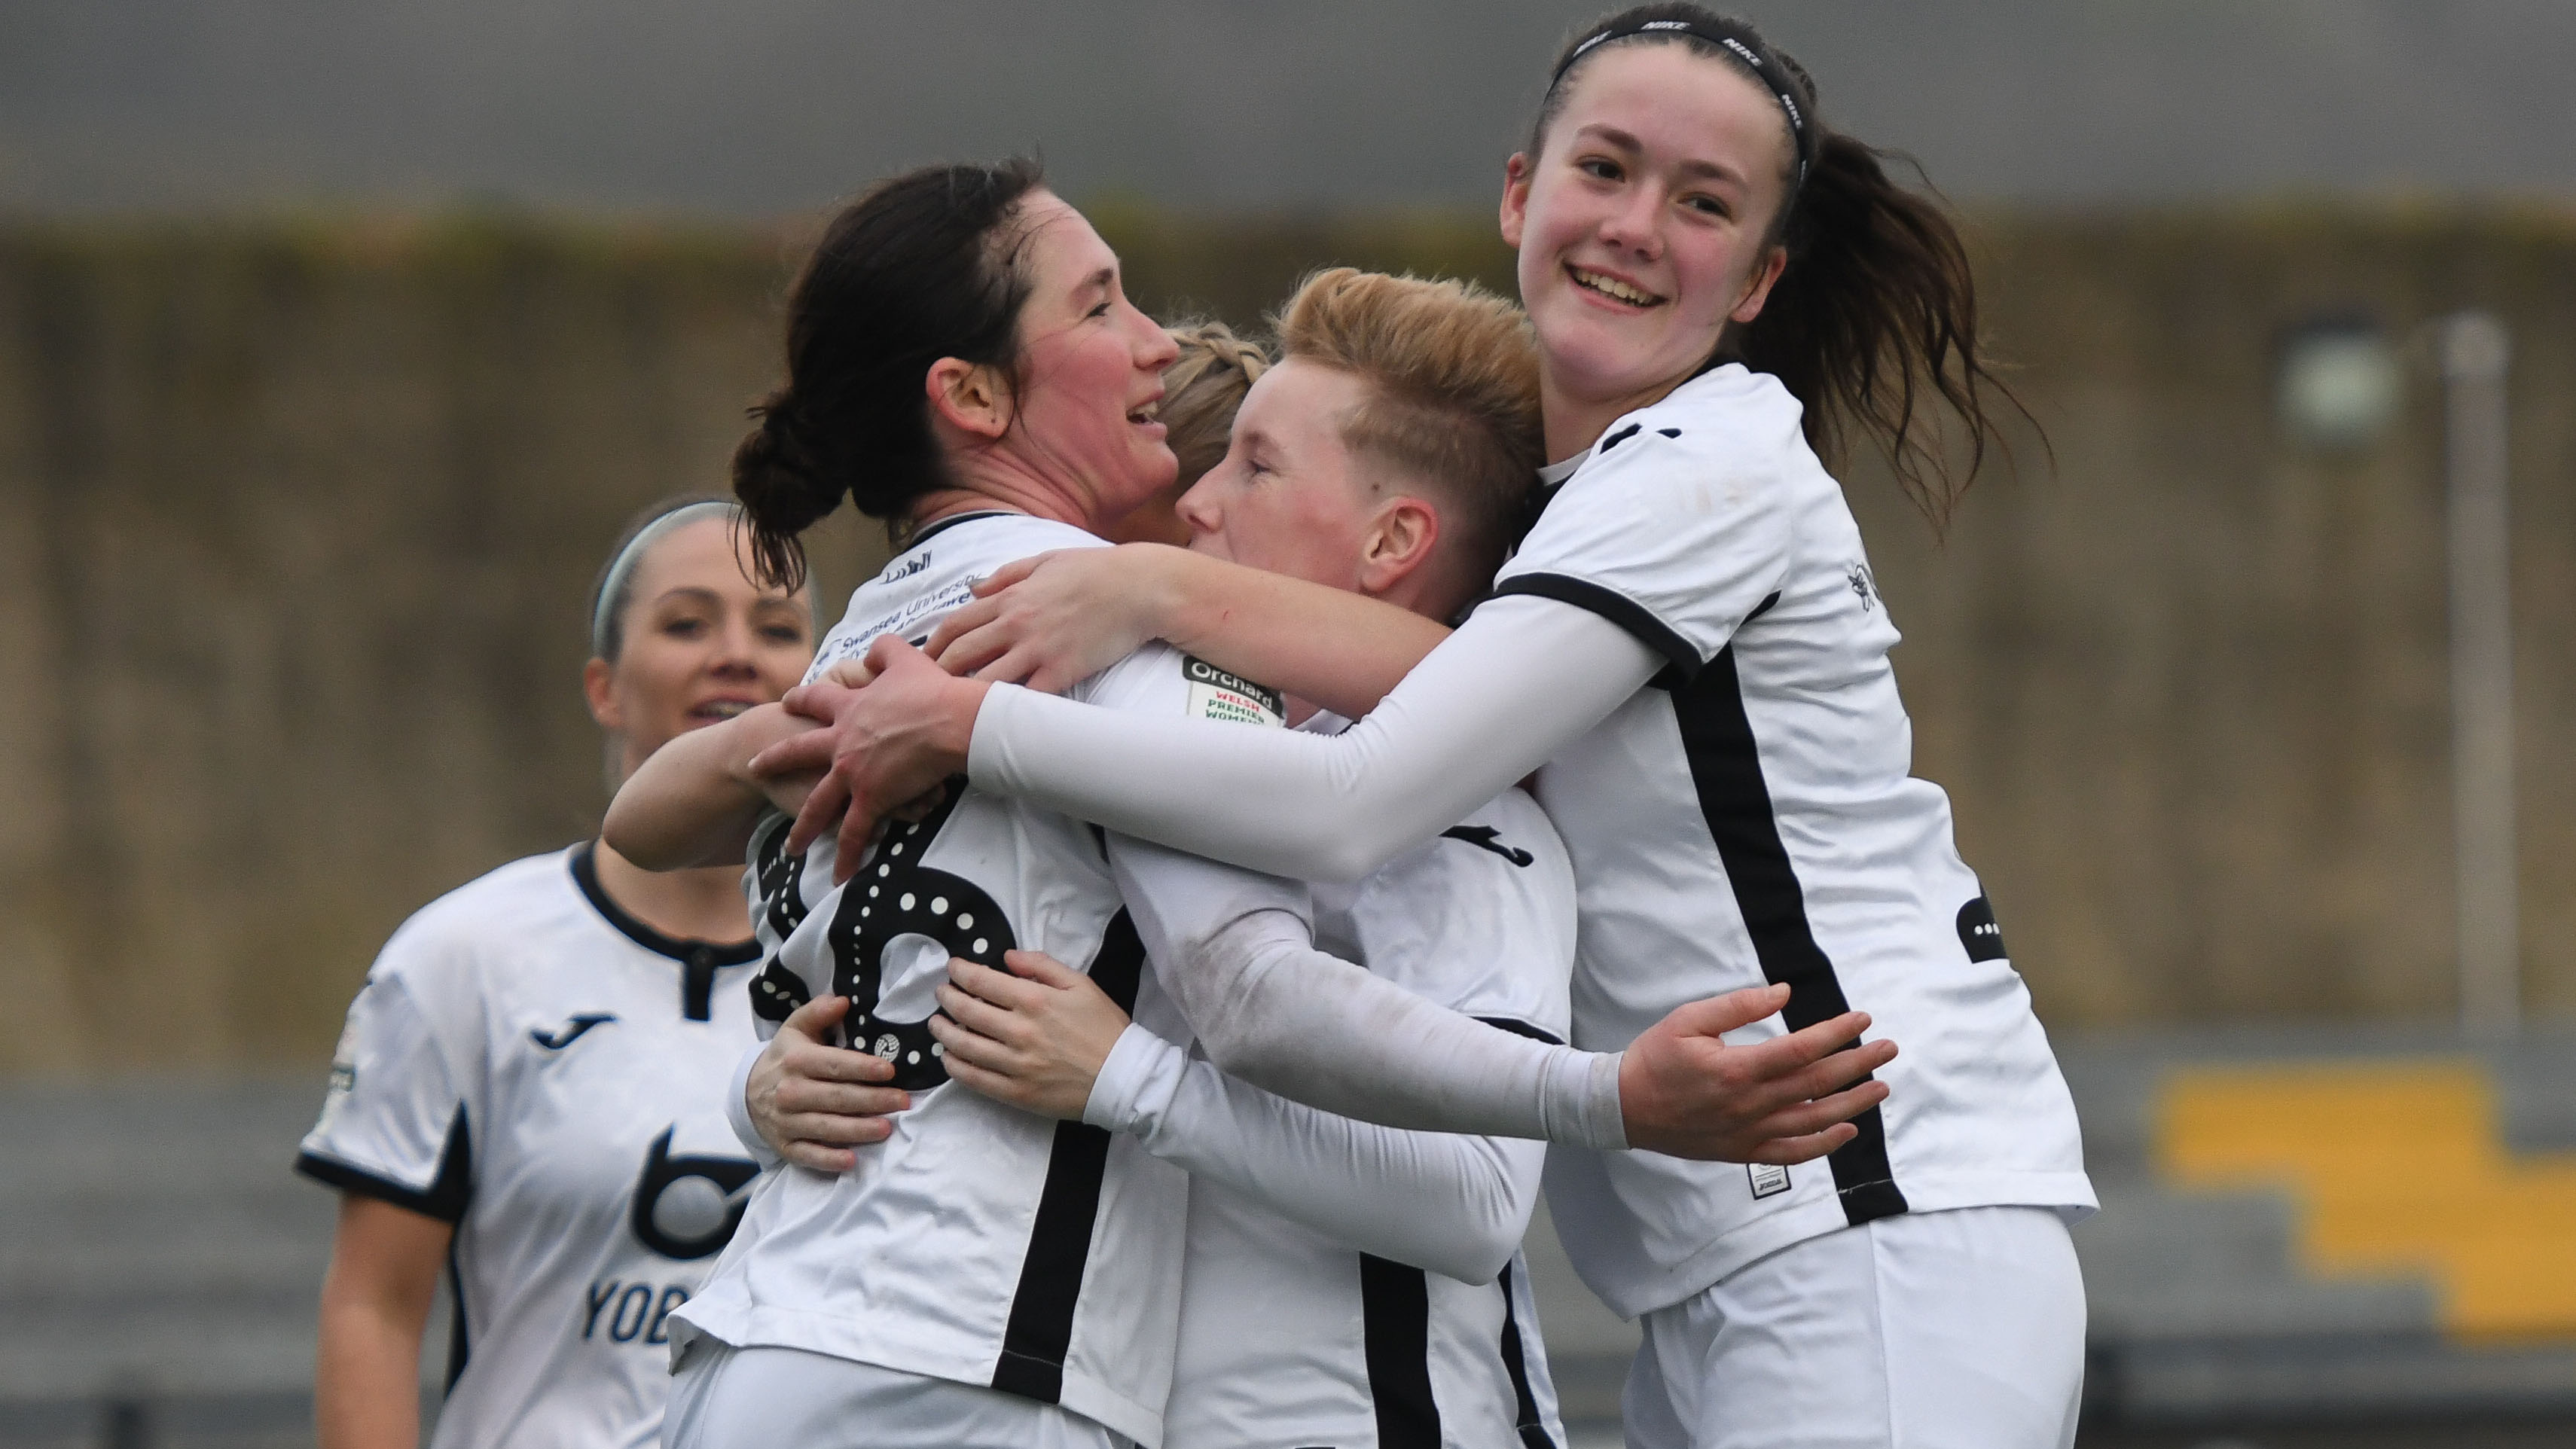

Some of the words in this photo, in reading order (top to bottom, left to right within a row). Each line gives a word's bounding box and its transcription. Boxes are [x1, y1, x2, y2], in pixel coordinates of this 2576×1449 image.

[1722, 38, 1763, 67] NIKE
[840, 611, 902, 654] Swansea
[1191, 662, 1272, 709] Orchard
[1207, 698, 1265, 724] PREMIER
[1216, 691, 1260, 712] WELSH
